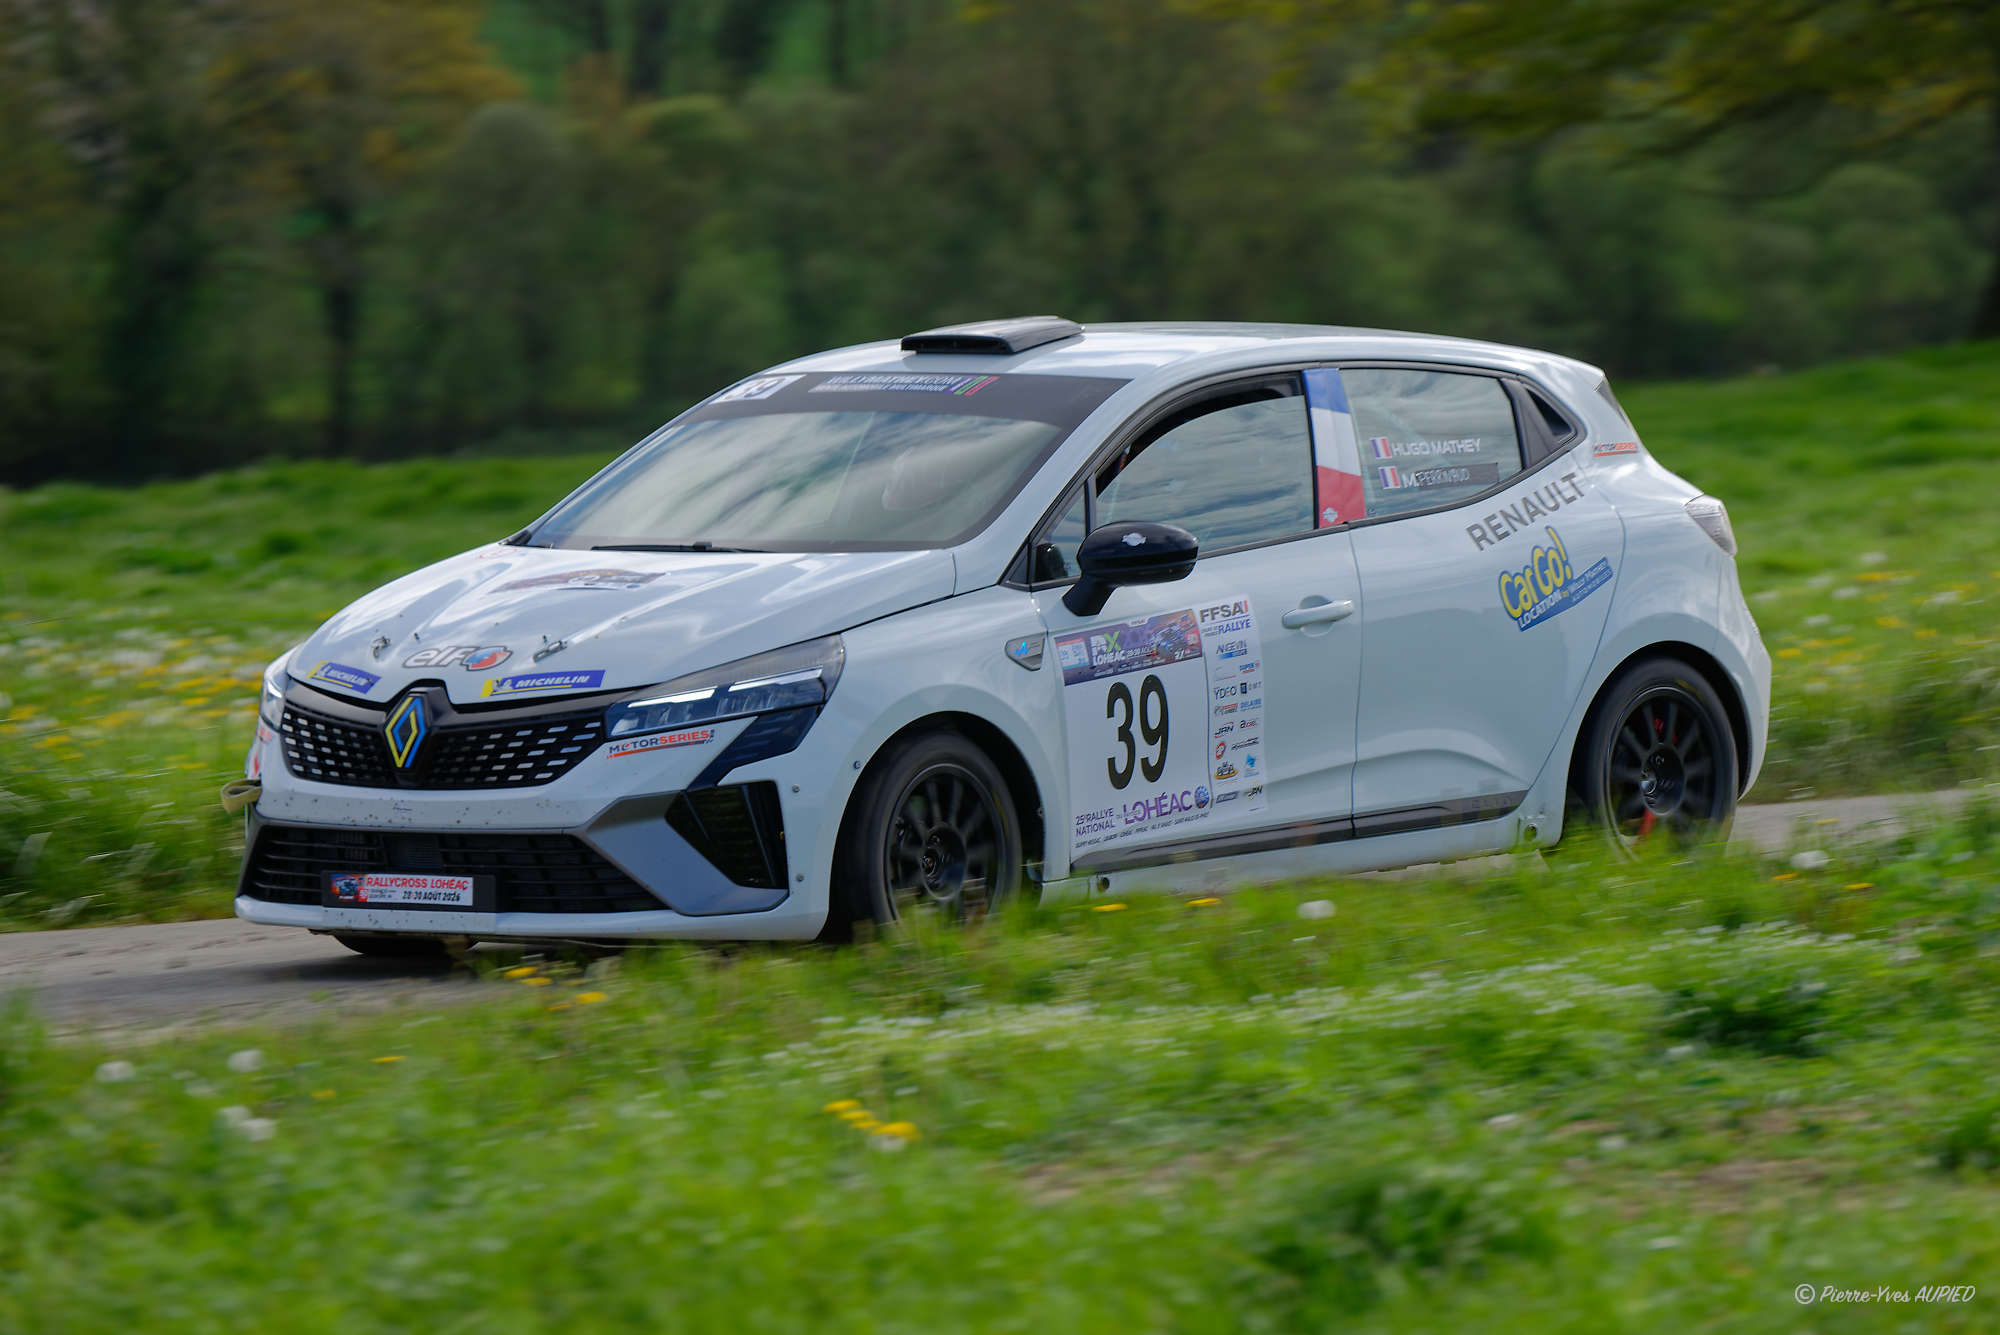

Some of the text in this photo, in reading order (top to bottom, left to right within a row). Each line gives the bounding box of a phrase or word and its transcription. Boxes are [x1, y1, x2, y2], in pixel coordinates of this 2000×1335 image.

[1391, 438, 1481, 456] HUGO MATHEY
[1465, 472, 1584, 551] RENAULT
[1499, 526, 1573, 619] CarGo!
[1200, 600, 1244, 623] FFSA
[1518, 588, 1562, 628] LOCATION
[1218, 619, 1250, 634] RALLYE
[515, 674, 591, 689] MICHELIN
[608, 729, 710, 754] MOTORSERIES
[1106, 674, 1169, 790] 39
[1087, 807, 1114, 823] RALLYE
[1123, 791, 1193, 824] LOHÉAC
[1075, 819, 1116, 837] NATIONAL
[366, 876, 428, 888] RALLYCROSS
